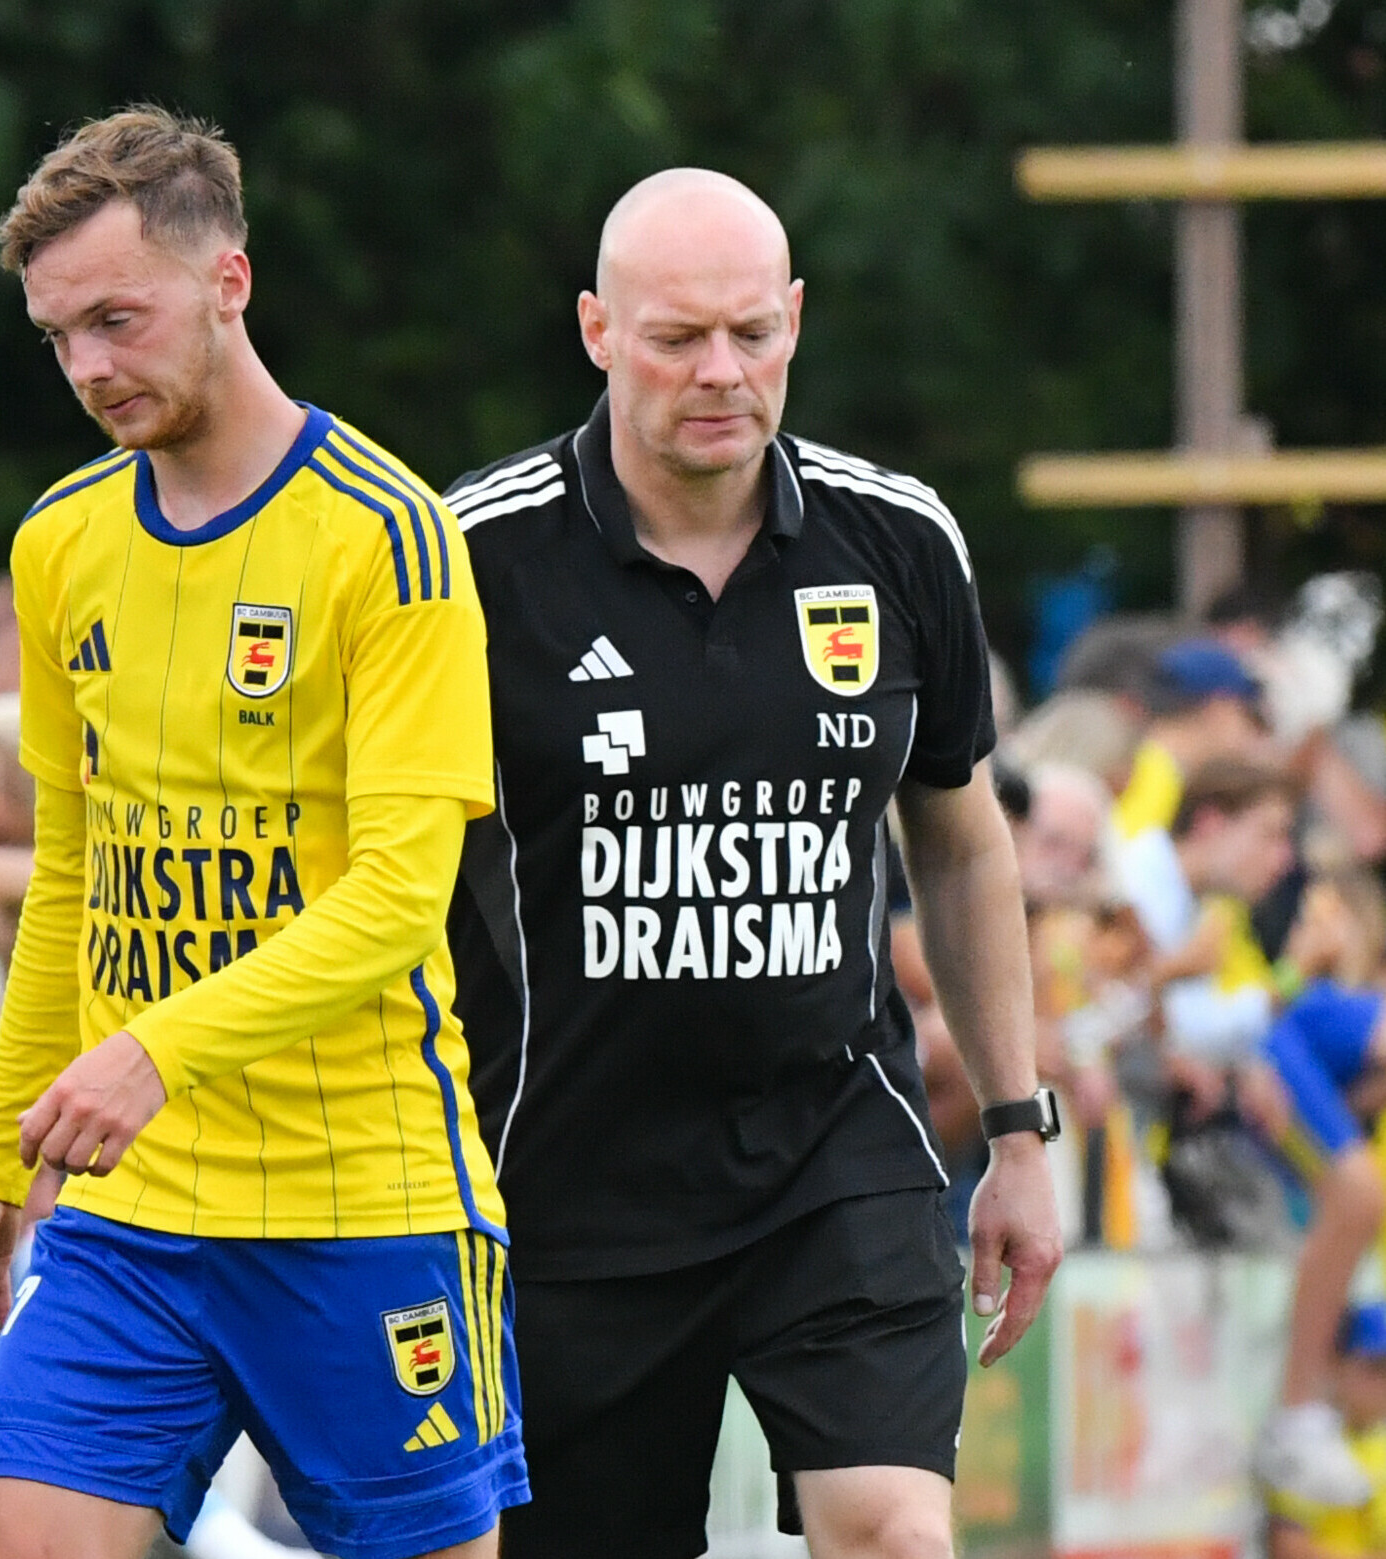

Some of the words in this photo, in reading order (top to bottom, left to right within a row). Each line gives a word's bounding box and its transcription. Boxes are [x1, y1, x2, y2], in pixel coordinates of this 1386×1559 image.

[817, 589, 871, 599] CAMBUUR
[239, 709, 275, 726] BALK
[817, 713, 876, 748] ND
[584, 778, 862, 824] BOUWGROEP
[582, 820, 851, 898] DIJKSTRA
[87, 919, 285, 1003] DRAISM
[582, 899, 842, 980] DRAISMA
